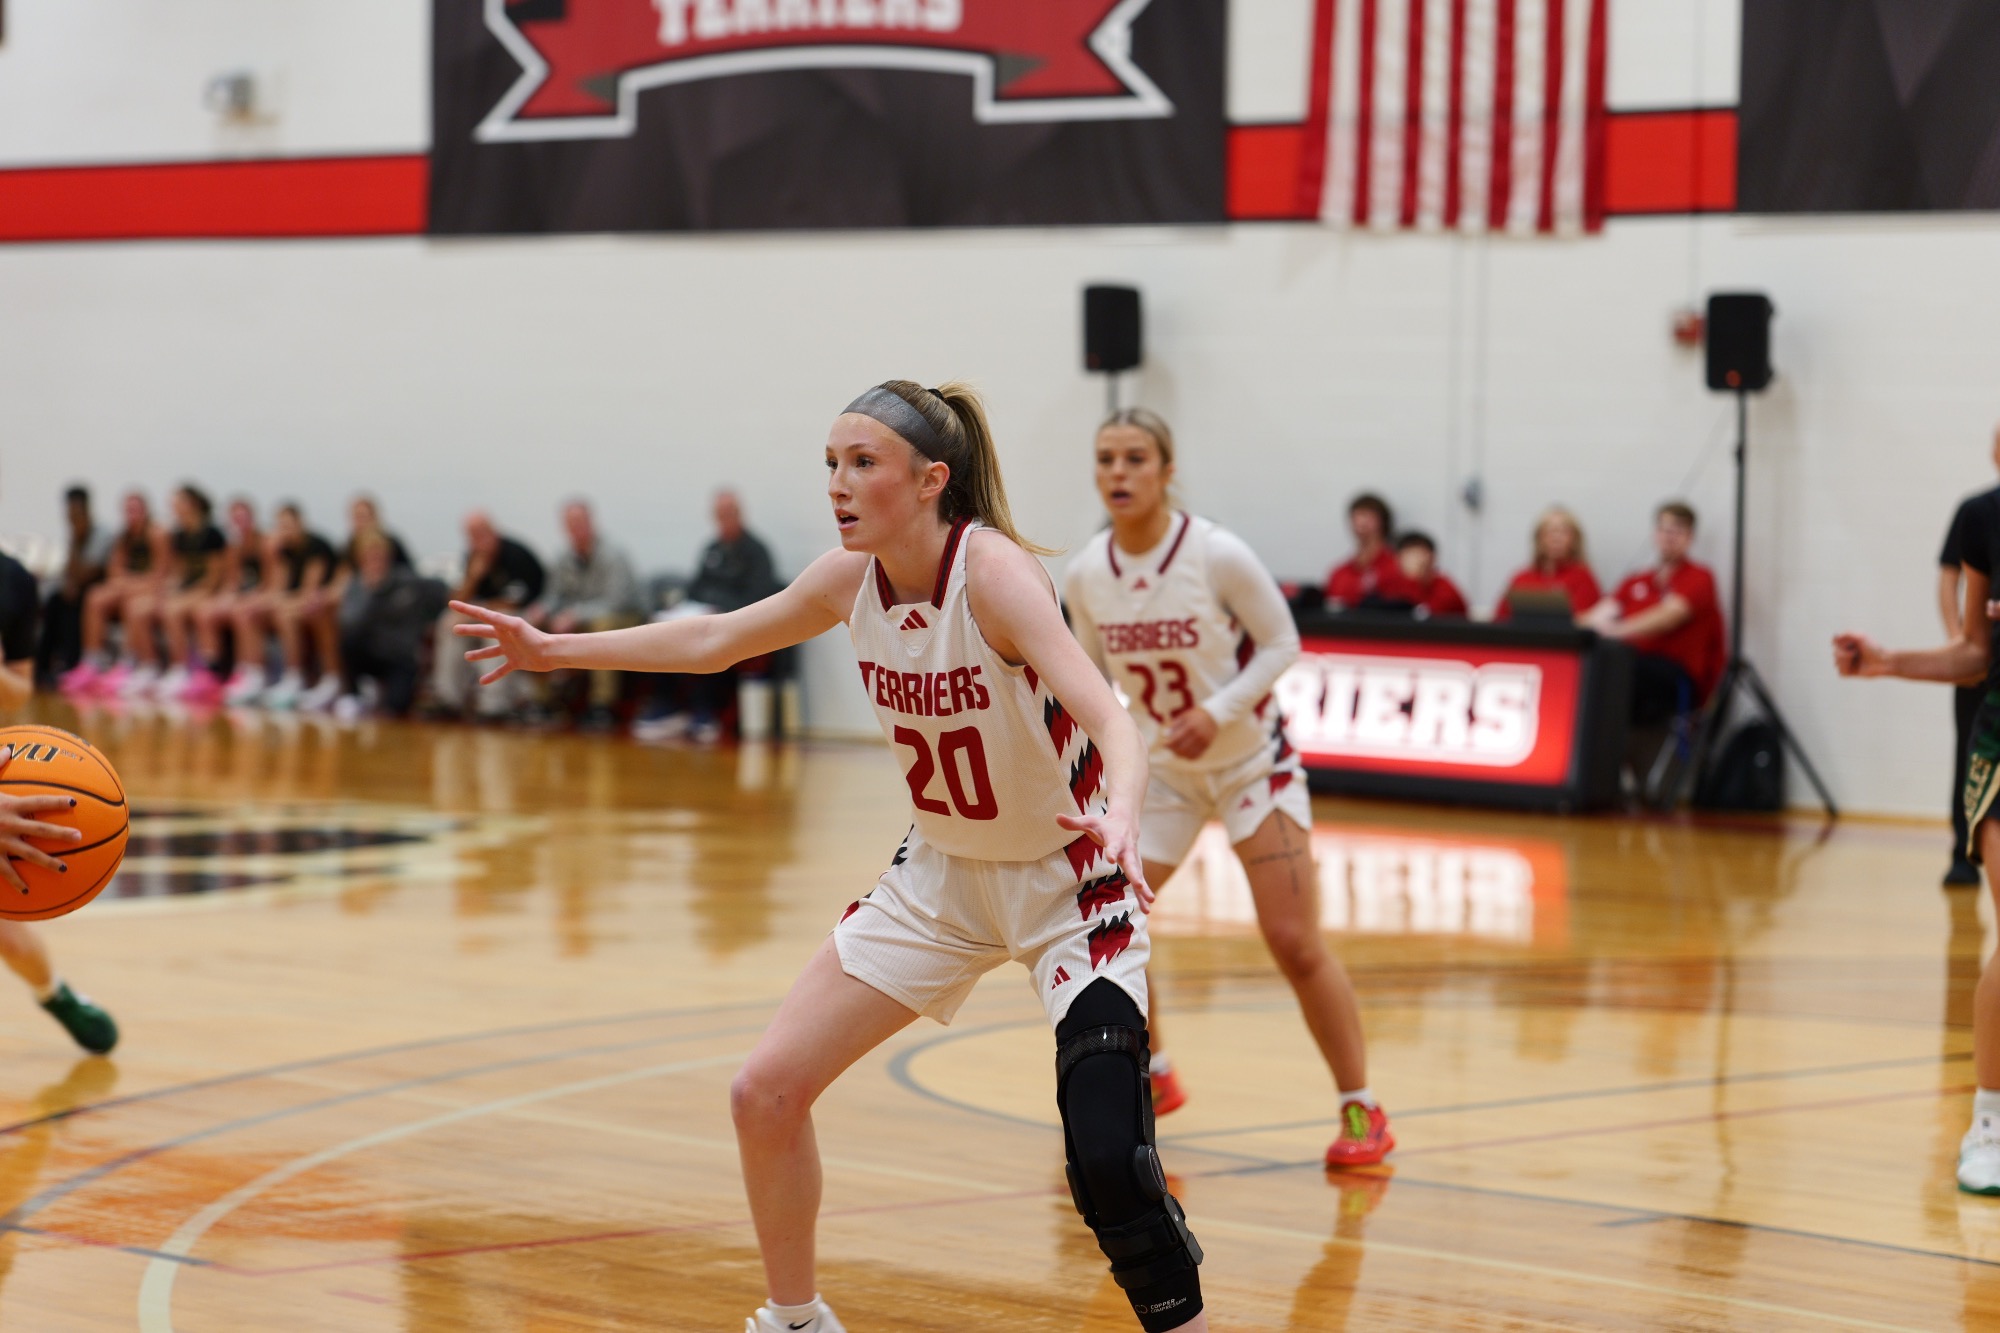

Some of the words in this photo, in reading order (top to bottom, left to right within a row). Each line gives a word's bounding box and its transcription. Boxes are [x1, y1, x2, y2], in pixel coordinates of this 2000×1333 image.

[1098, 616, 1198, 654] TERRIERS
[858, 661, 990, 717] TERRIERS
[1126, 659, 1194, 724] 23
[894, 725, 998, 820] 20
[1150, 1298, 1175, 1310] COPPER
